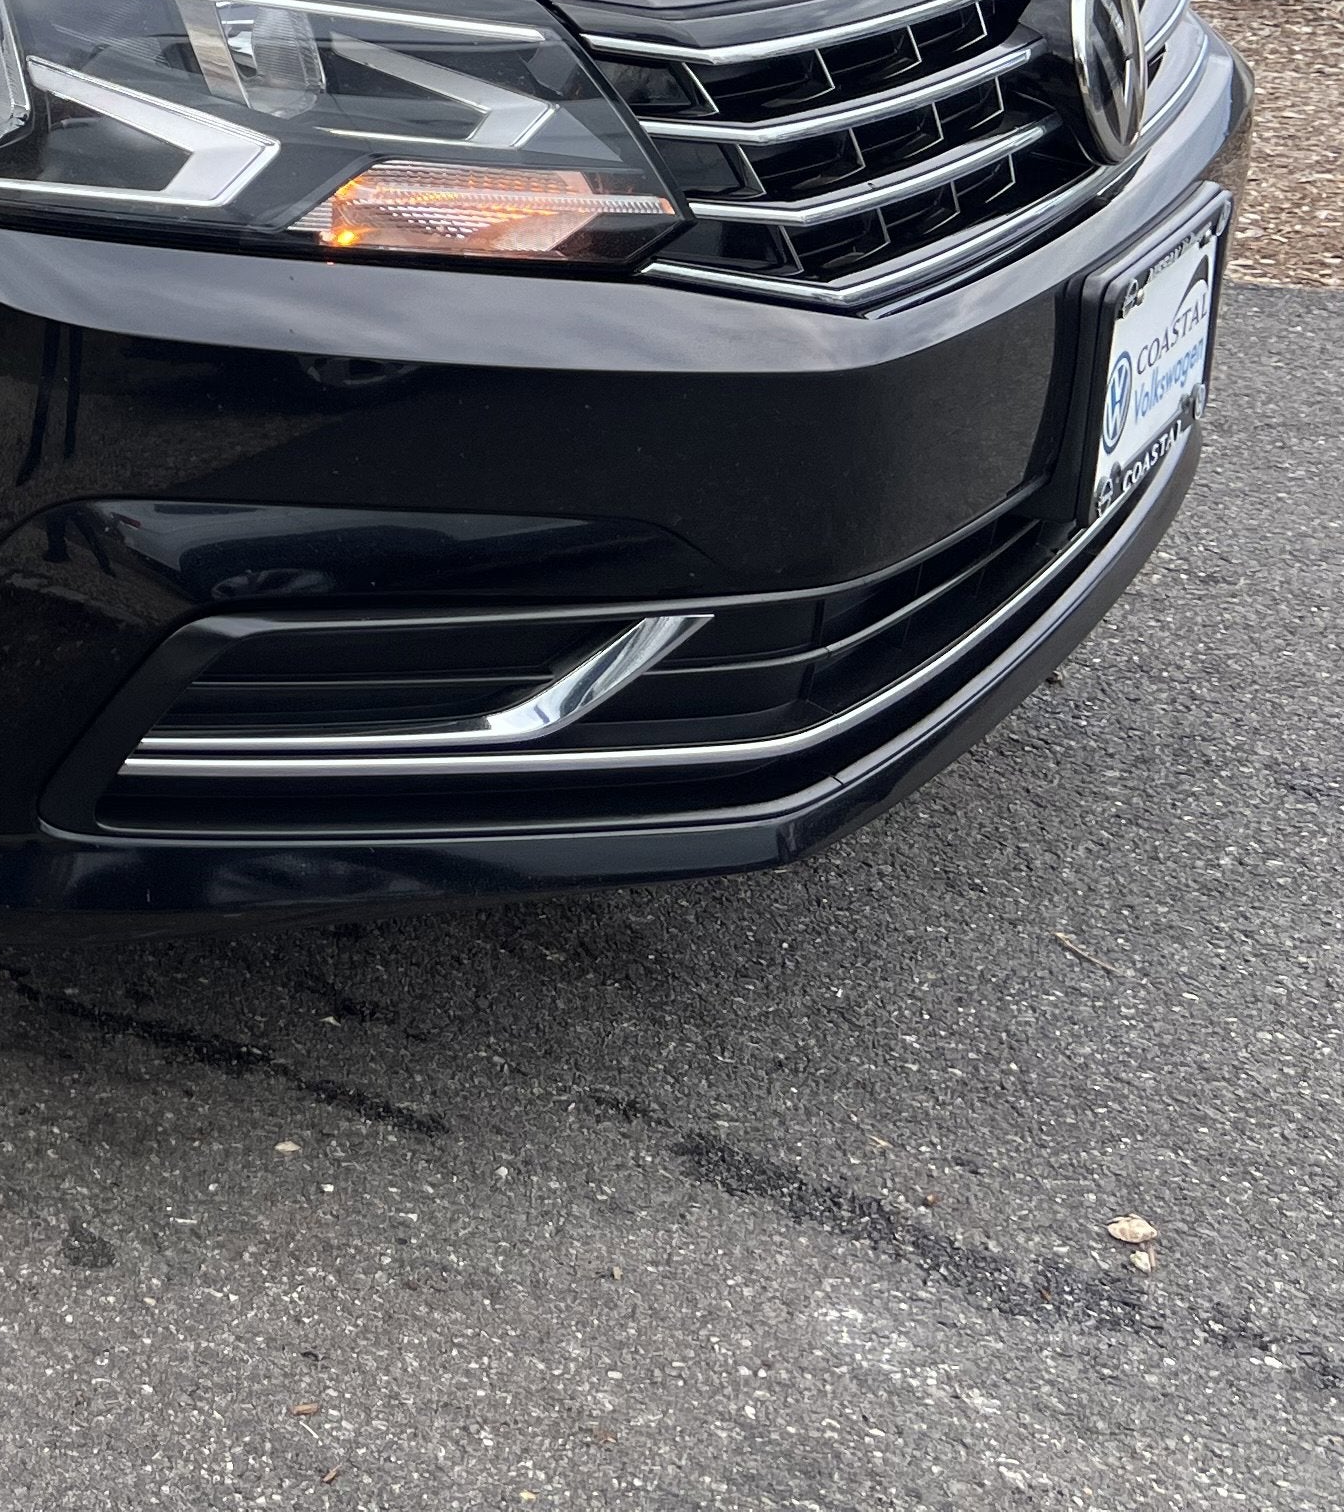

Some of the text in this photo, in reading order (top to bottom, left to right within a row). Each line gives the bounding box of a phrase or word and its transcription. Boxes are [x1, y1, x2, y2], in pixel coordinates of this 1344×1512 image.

[1136, 290, 1209, 375] COASTAL
[1134, 338, 1205, 424] Volkswagen
[1123, 419, 1189, 492] COASTAL
